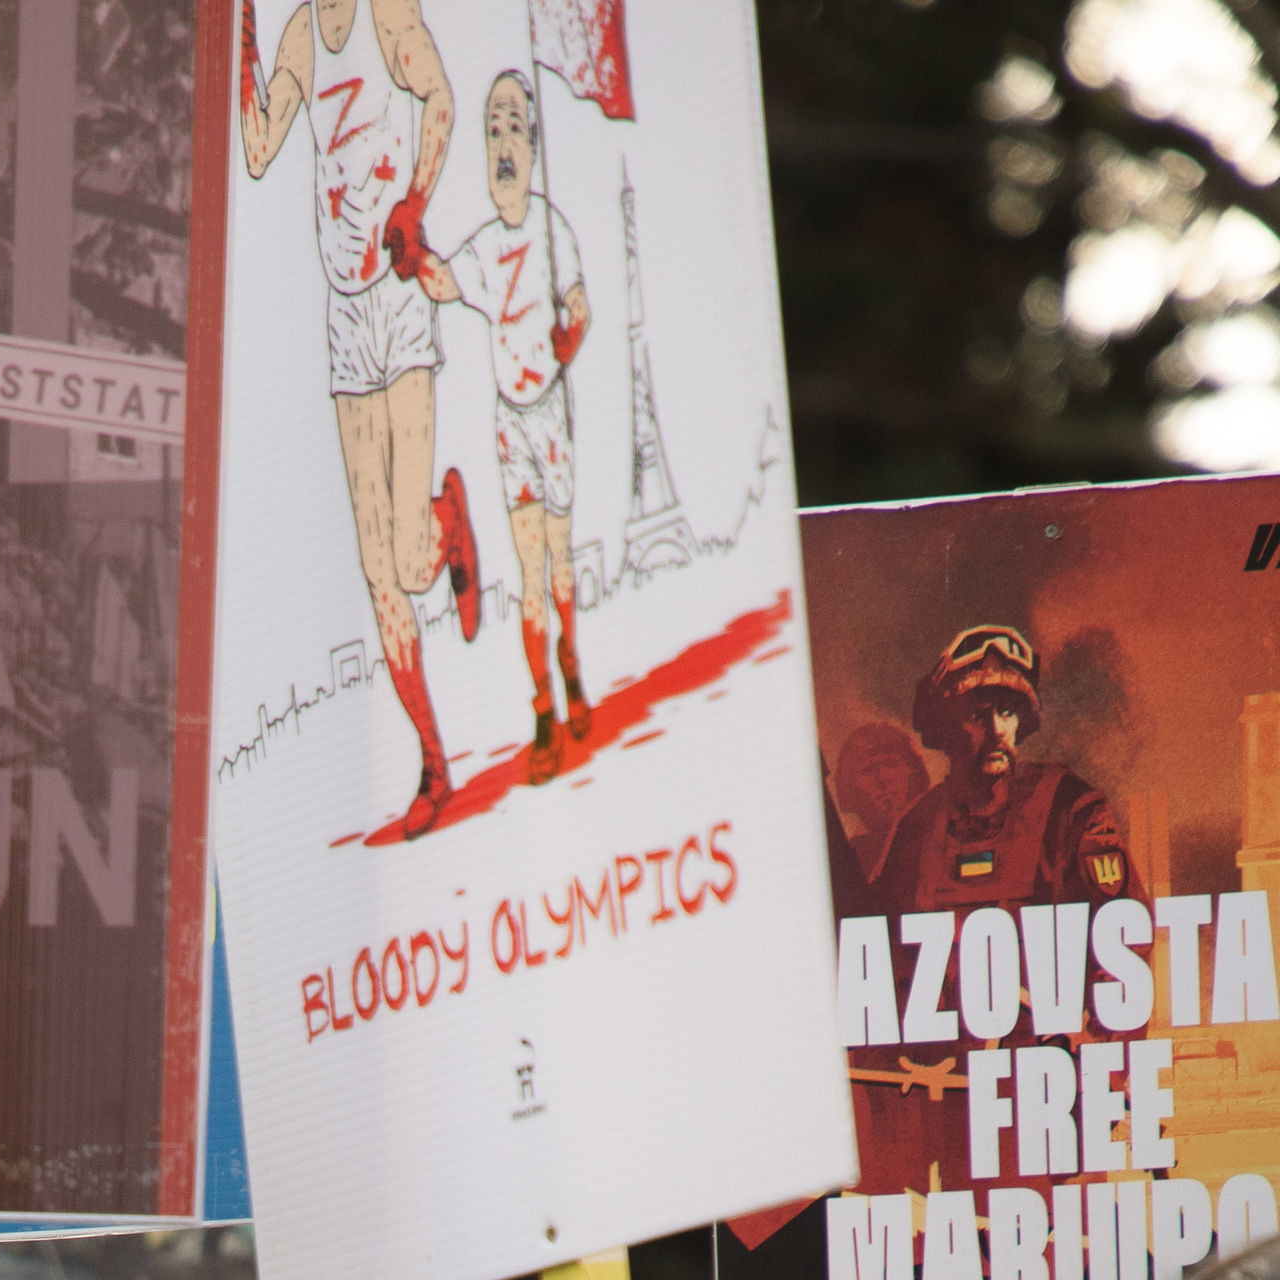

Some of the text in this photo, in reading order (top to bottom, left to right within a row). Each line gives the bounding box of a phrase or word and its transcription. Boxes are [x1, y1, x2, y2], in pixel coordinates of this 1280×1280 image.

[301, 821, 738, 1043] BLOODY OLYMPICS
[838, 890, 1280, 1047] AZOVSTA
[968, 1039, 1176, 1179] FREE
